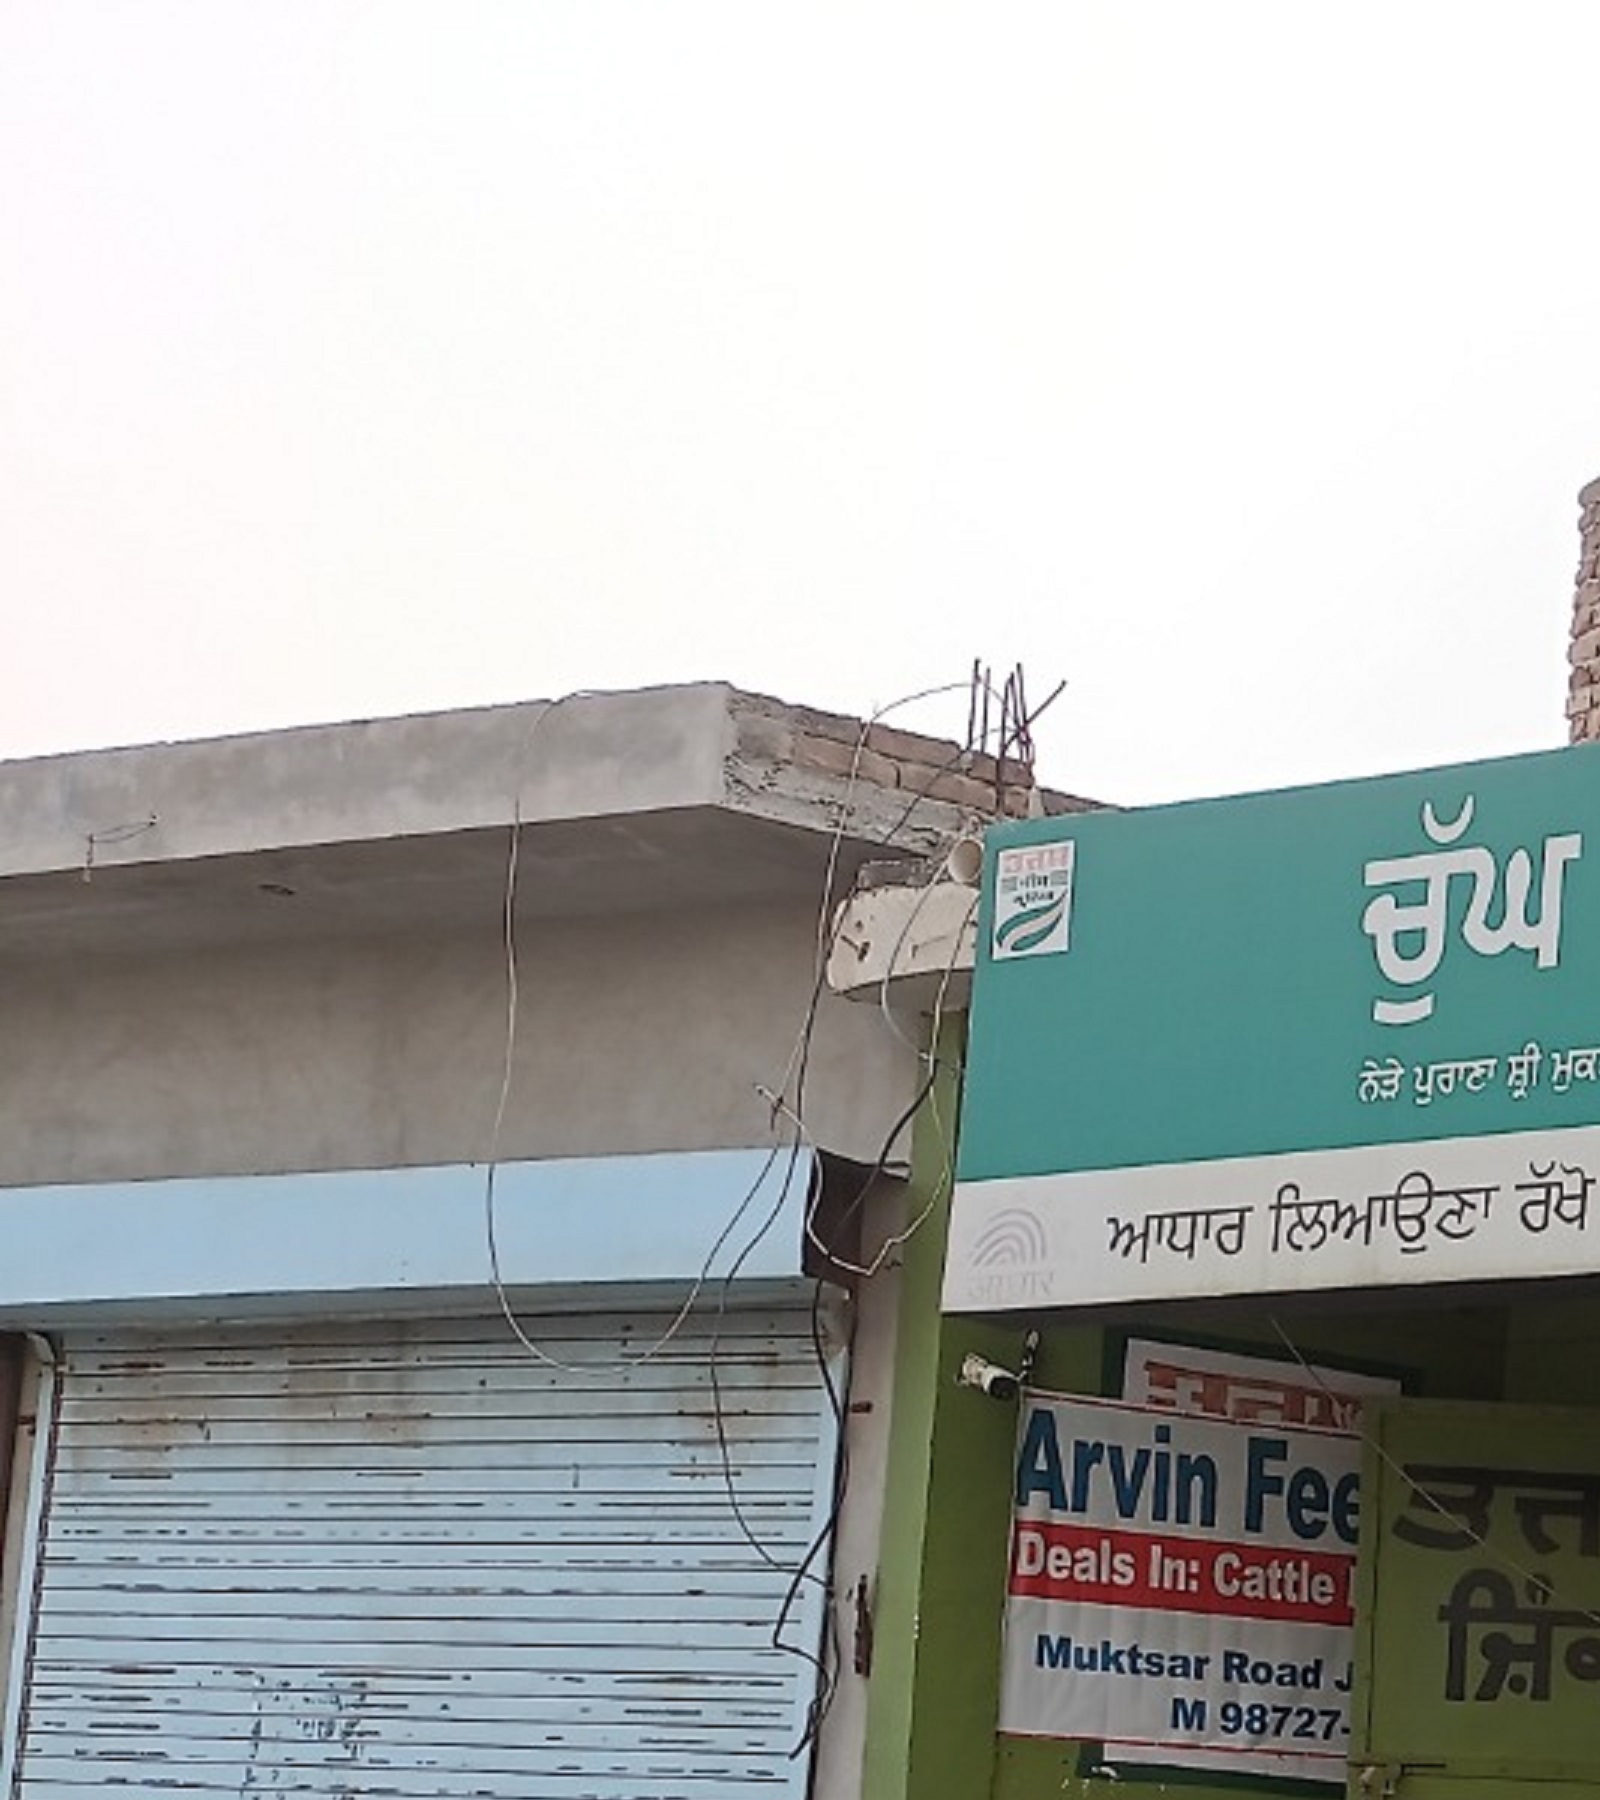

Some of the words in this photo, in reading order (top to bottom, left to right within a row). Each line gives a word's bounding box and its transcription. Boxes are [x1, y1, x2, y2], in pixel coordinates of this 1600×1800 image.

[1361, 794, 1582, 1024] ਚੁੱਘ
[1358, 1057, 1405, 1102] ਨੇੜੇ
[1414, 1057, 1498, 1105] ਪੁਰਾਣਾ
[1108, 1206, 1253, 1264] ਆਧਾਰ
[1269, 1171, 1500, 1254] ਲਿਆਉਣਾ
[1515, 1160, 1597, 1234] ਰੱਖੋ
[1017, 1408, 1218, 1528] Arvin
[1016, 1531, 1136, 1586] Deals
[1147, 1545, 1200, 1592] In:
[1213, 1552, 1336, 1604] Cattle
[1035, 1634, 1210, 1680] Muktsar
[1222, 1650, 1323, 1690] Road
[1170, 1697, 1206, 1731] M
